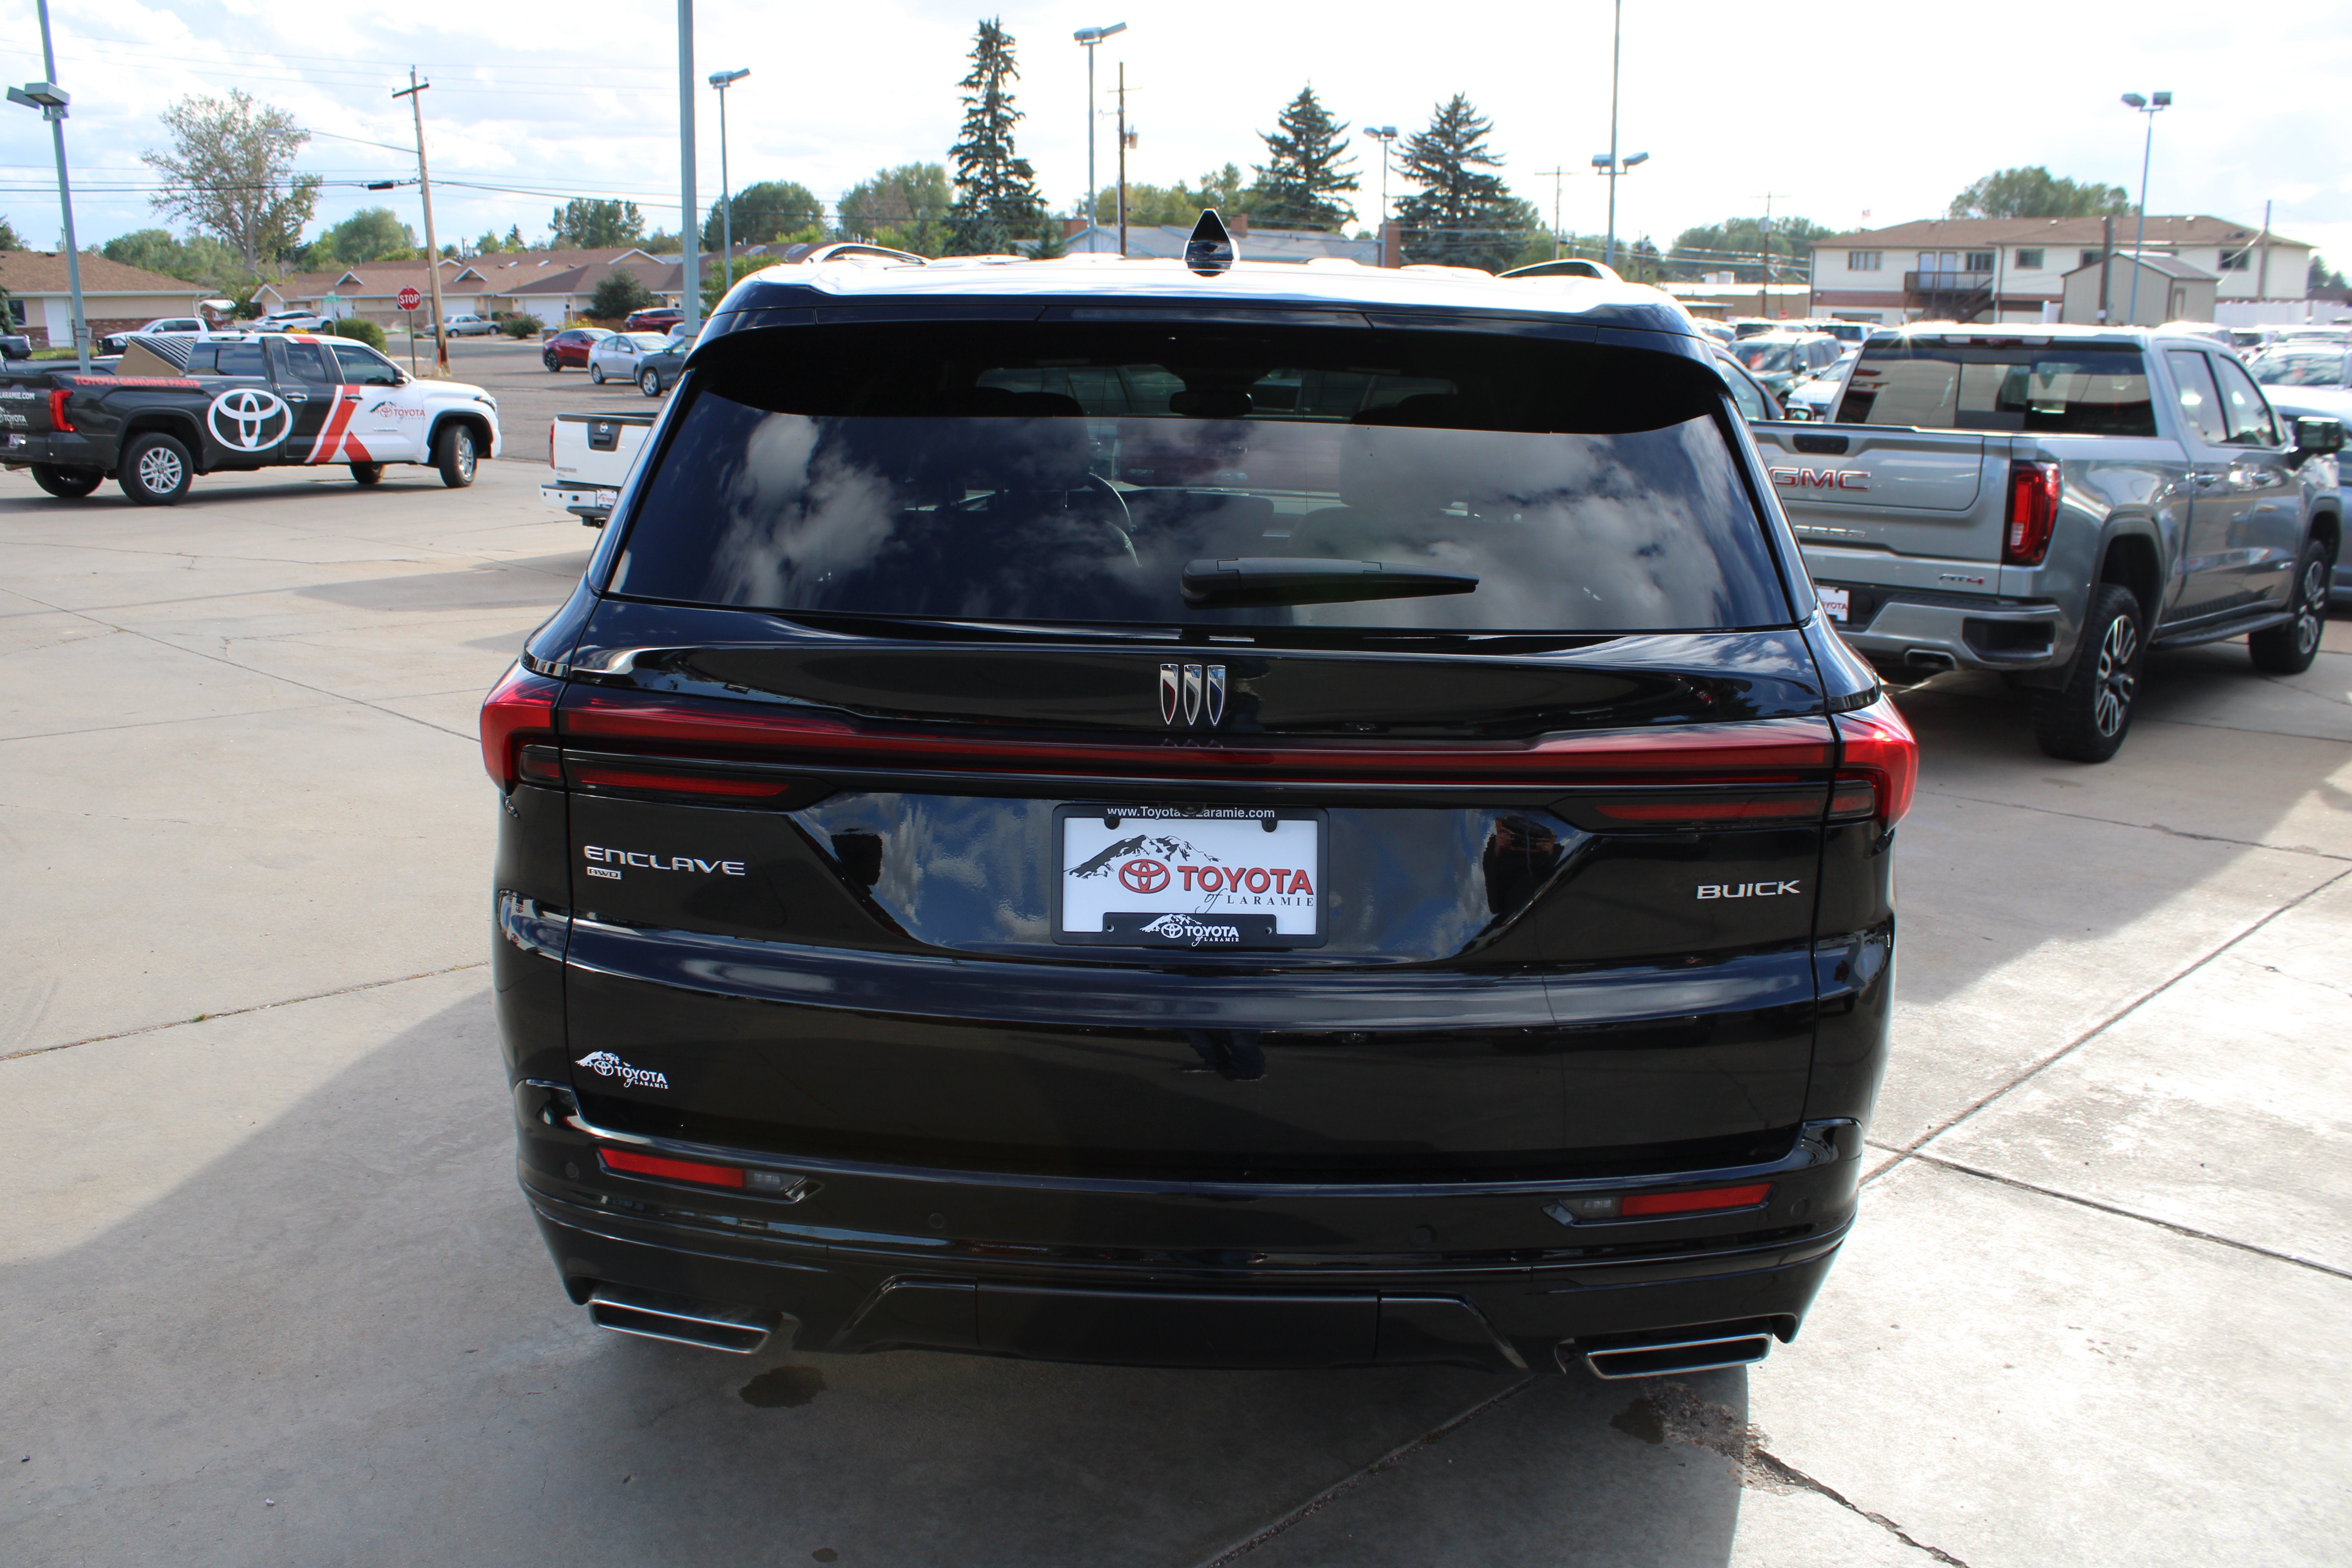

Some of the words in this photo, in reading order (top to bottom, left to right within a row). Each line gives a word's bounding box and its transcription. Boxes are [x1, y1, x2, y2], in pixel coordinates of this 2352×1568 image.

[399, 294, 419, 304] STOP
[73, 376, 116, 385] TOYOTA
[118, 377, 168, 386] GENUINE
[167, 379, 201, 388] PARTS
[3, 414, 27, 423] TOYOTA
[1770, 466, 1872, 490] GMC
[1939, 573, 1985, 586] AT4
[1822, 601, 1849, 610] YOTA
[1107, 806, 1275, 819] www.Toyotaaramie.com
[584, 845, 746, 876] ENCLAVE
[588, 868, 619, 878] AWD
[1177, 866, 1314, 895] TOYOTA
[1697, 880, 1801, 899] BUICK
[1195, 888, 1228, 914] of
[1226, 895, 1314, 906] LARAMIE
[1184, 925, 1239, 937] TOYOTA
[1192, 934, 1205, 947] of
[614, 1066, 667, 1084] TOYOTA
[624, 1076, 635, 1088] of
[634, 1080, 668, 1089] LARAMIE
